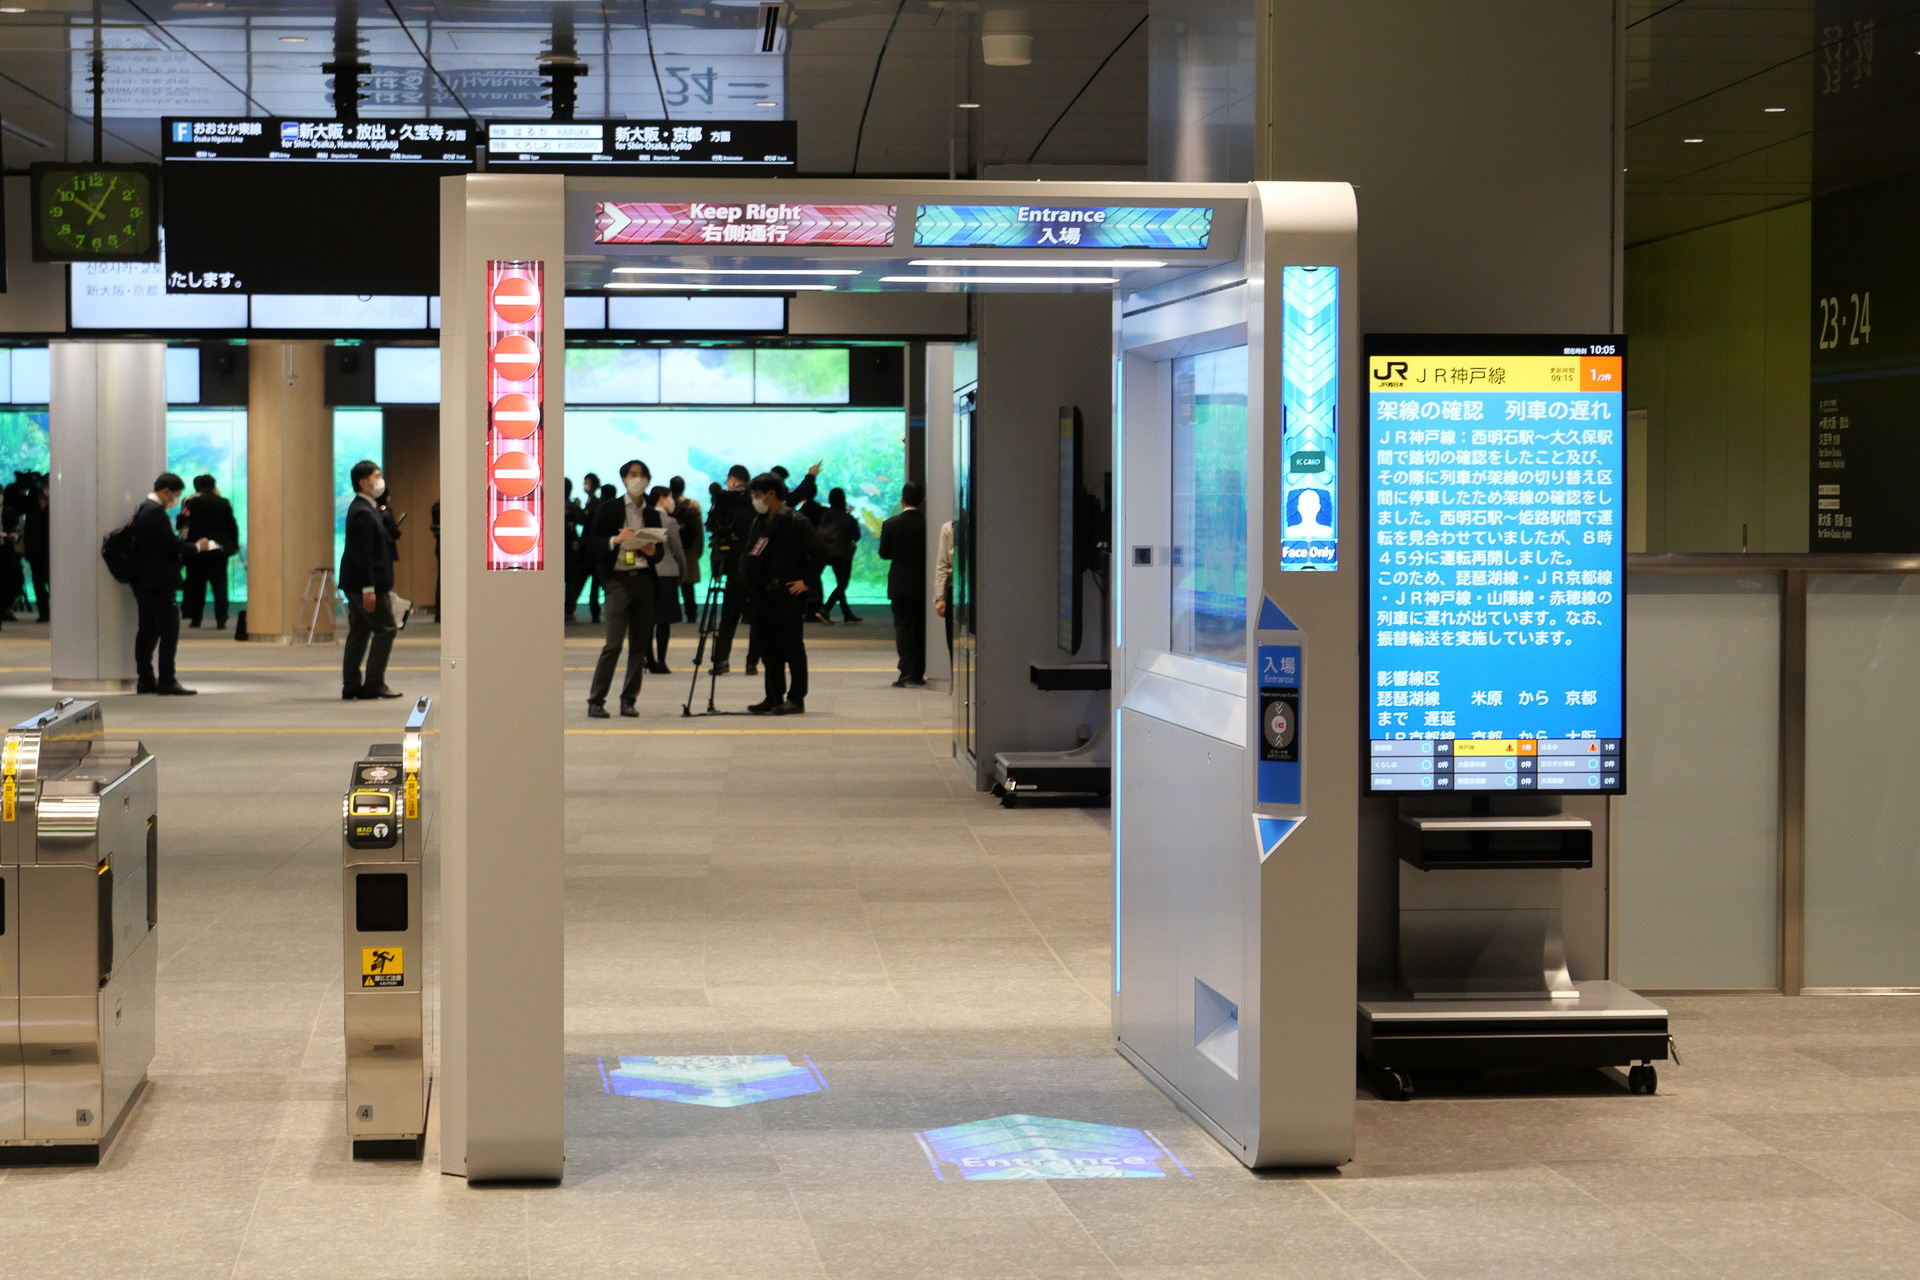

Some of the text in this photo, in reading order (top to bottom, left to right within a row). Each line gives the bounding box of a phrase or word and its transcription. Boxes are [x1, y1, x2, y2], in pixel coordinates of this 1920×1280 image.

[194, 122, 262, 135] おおさか東線
[299, 123, 466, 141] 新大阪・放出・久宝寺 方面
[557, 128, 590, 136] HARUKA
[615, 126, 731, 143] 新大阪・京都 方面
[281, 140, 294, 148] for
[615, 142, 627, 150] for
[74, 179, 86, 191] 11
[89, 175, 104, 186] 12
[60, 190, 75, 202] 10
[122, 190, 132, 201] 2
[53, 206, 64, 217] 9
[130, 207, 140, 218] 3
[690, 204, 801, 224] Keep Right
[1018, 206, 1106, 224] Entrance
[61, 223, 71, 235] 8
[123, 224, 132, 235] 4
[701, 224, 790, 243] 右側通行
[1037, 226, 1081, 245] 入場
[76, 234, 86, 245] 7
[92, 237, 102, 249] 6
[108, 234, 118, 246] 5
[1590, 345, 1616, 355] 10:05
[1374, 362, 1408, 380] JR
[1416, 367, 1506, 385] JR神戸線
[1551, 374, 1574, 382] 09:15
[1377, 400, 1611, 421] 架線の確認 列車の遅れ
[1377, 449, 1603, 466] 間で踏切の確認をしたこと及び、
[1377, 469, 1613, 486] その際に列車が架線の切り替え区
[1377, 489, 1612, 506] 間に停車したため架線の確認をし
[1282, 546, 1335, 560] Face Only
[1376, 630, 1572, 646] 振替輸送を実施しています。
[1263, 656, 1296, 675] 入場
[1264, 675, 1294, 684] Entrance
[1377, 671, 1440, 687] 影響線区
[1376, 690, 1598, 707] 琵琶湖線 米原 から 京都
[1377, 711, 1456, 726] まで 遅延
[79, 1112, 87, 1123] 4
[361, 1108, 370, 1119] 4
[960, 1155, 1146, 1168] Entrance
